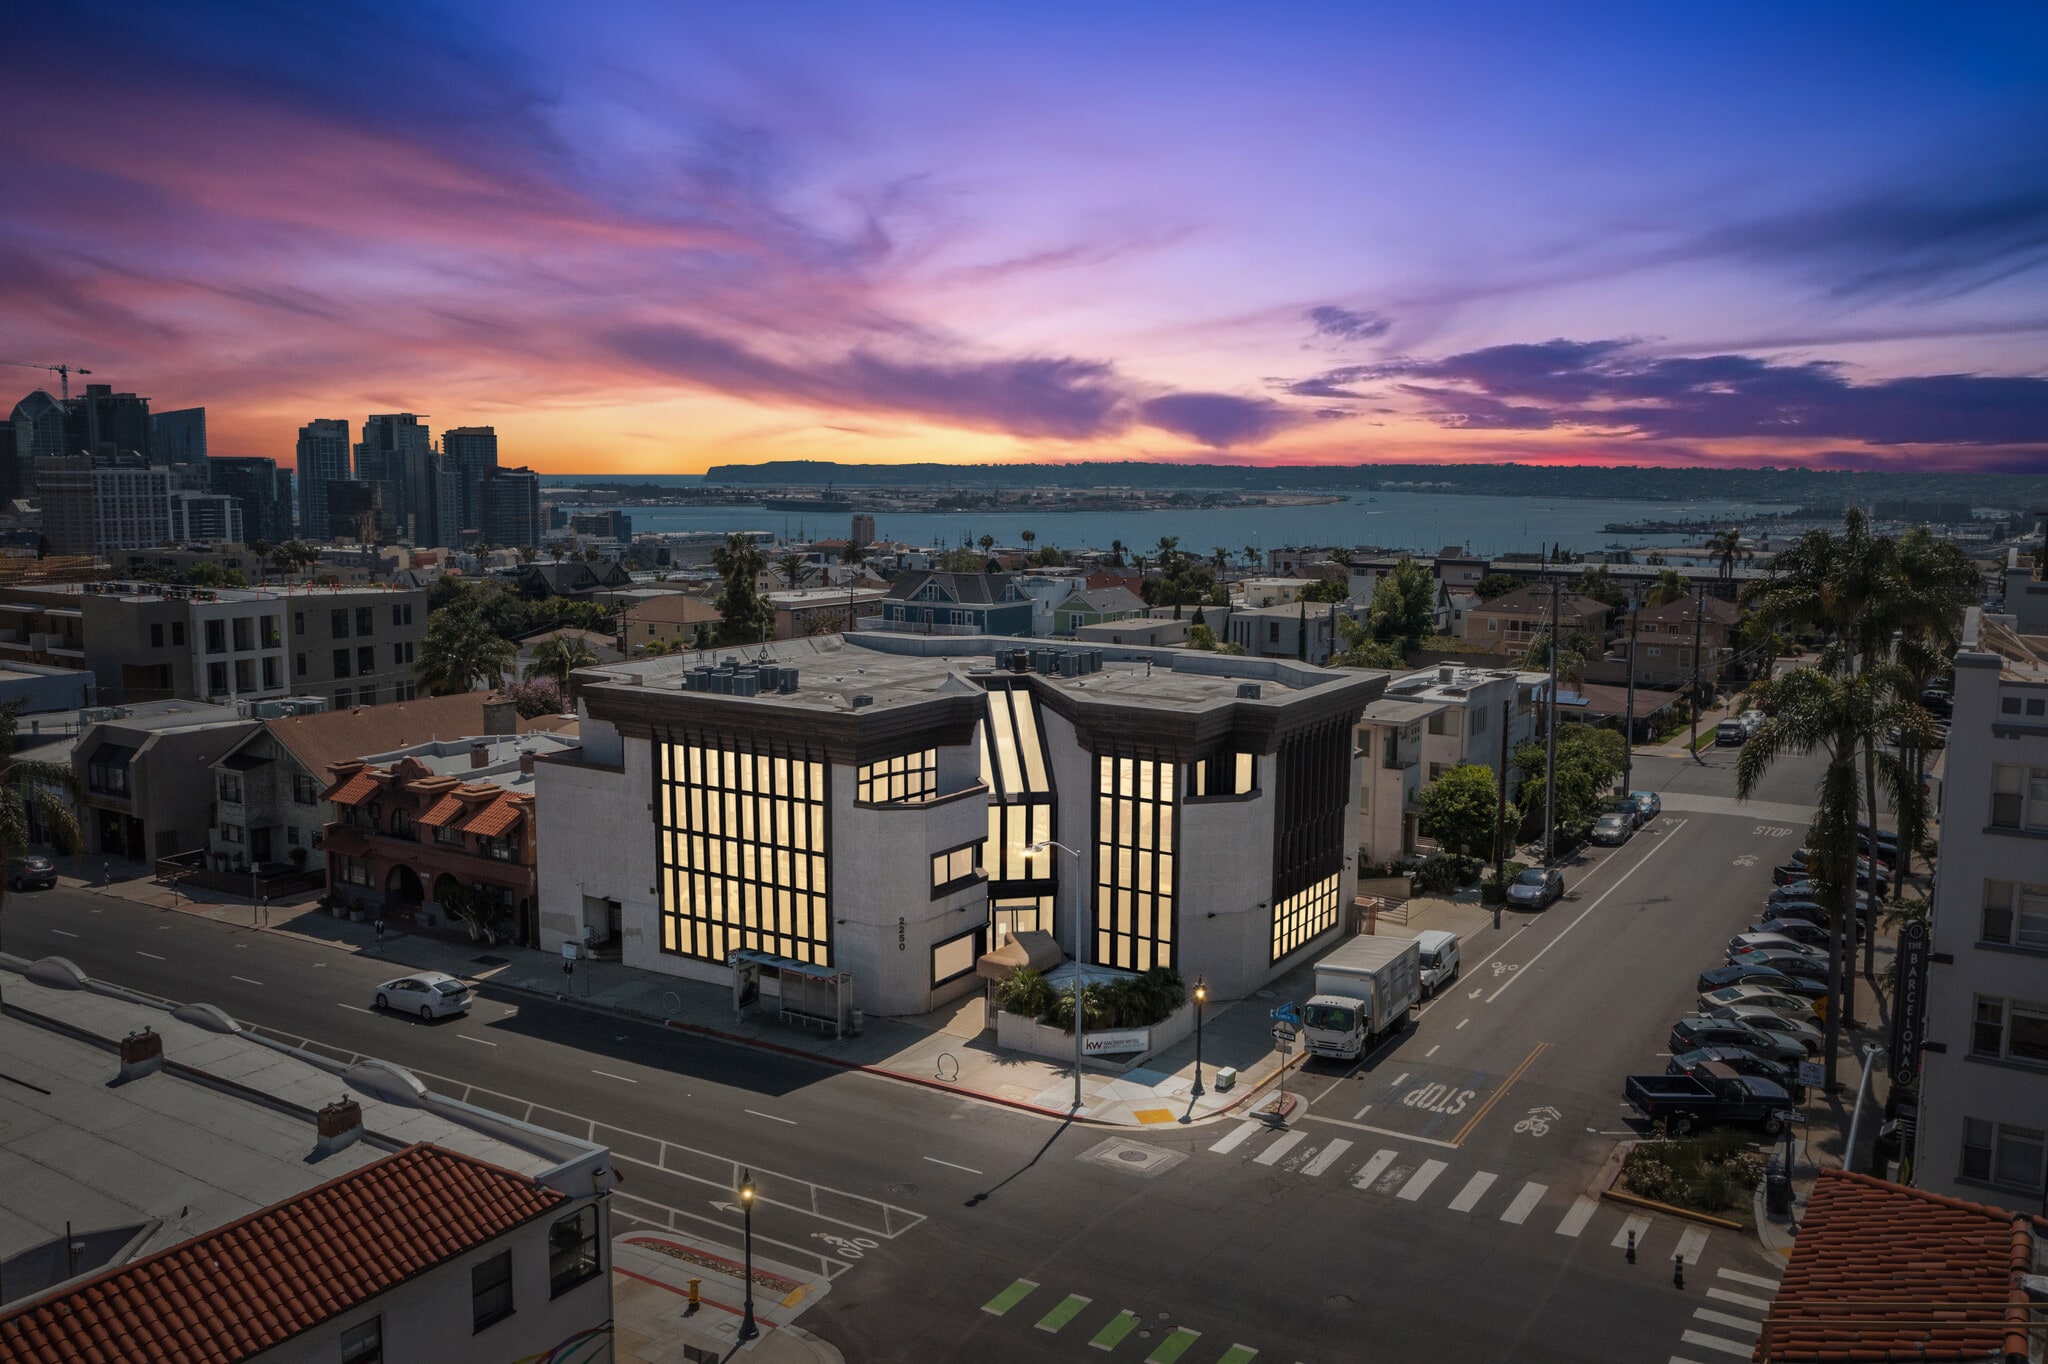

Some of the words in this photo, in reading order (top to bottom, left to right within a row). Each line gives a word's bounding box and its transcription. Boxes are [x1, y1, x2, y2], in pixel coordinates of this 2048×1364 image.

[1752, 825, 1793, 838] STOP
[898, 917, 906, 951] 2250
[1908, 942, 1923, 950] THE
[1901, 953, 1918, 1068] BARCELONA
[1086, 1039, 1103, 1050] kw
[1403, 1083, 1475, 1114] STOP
